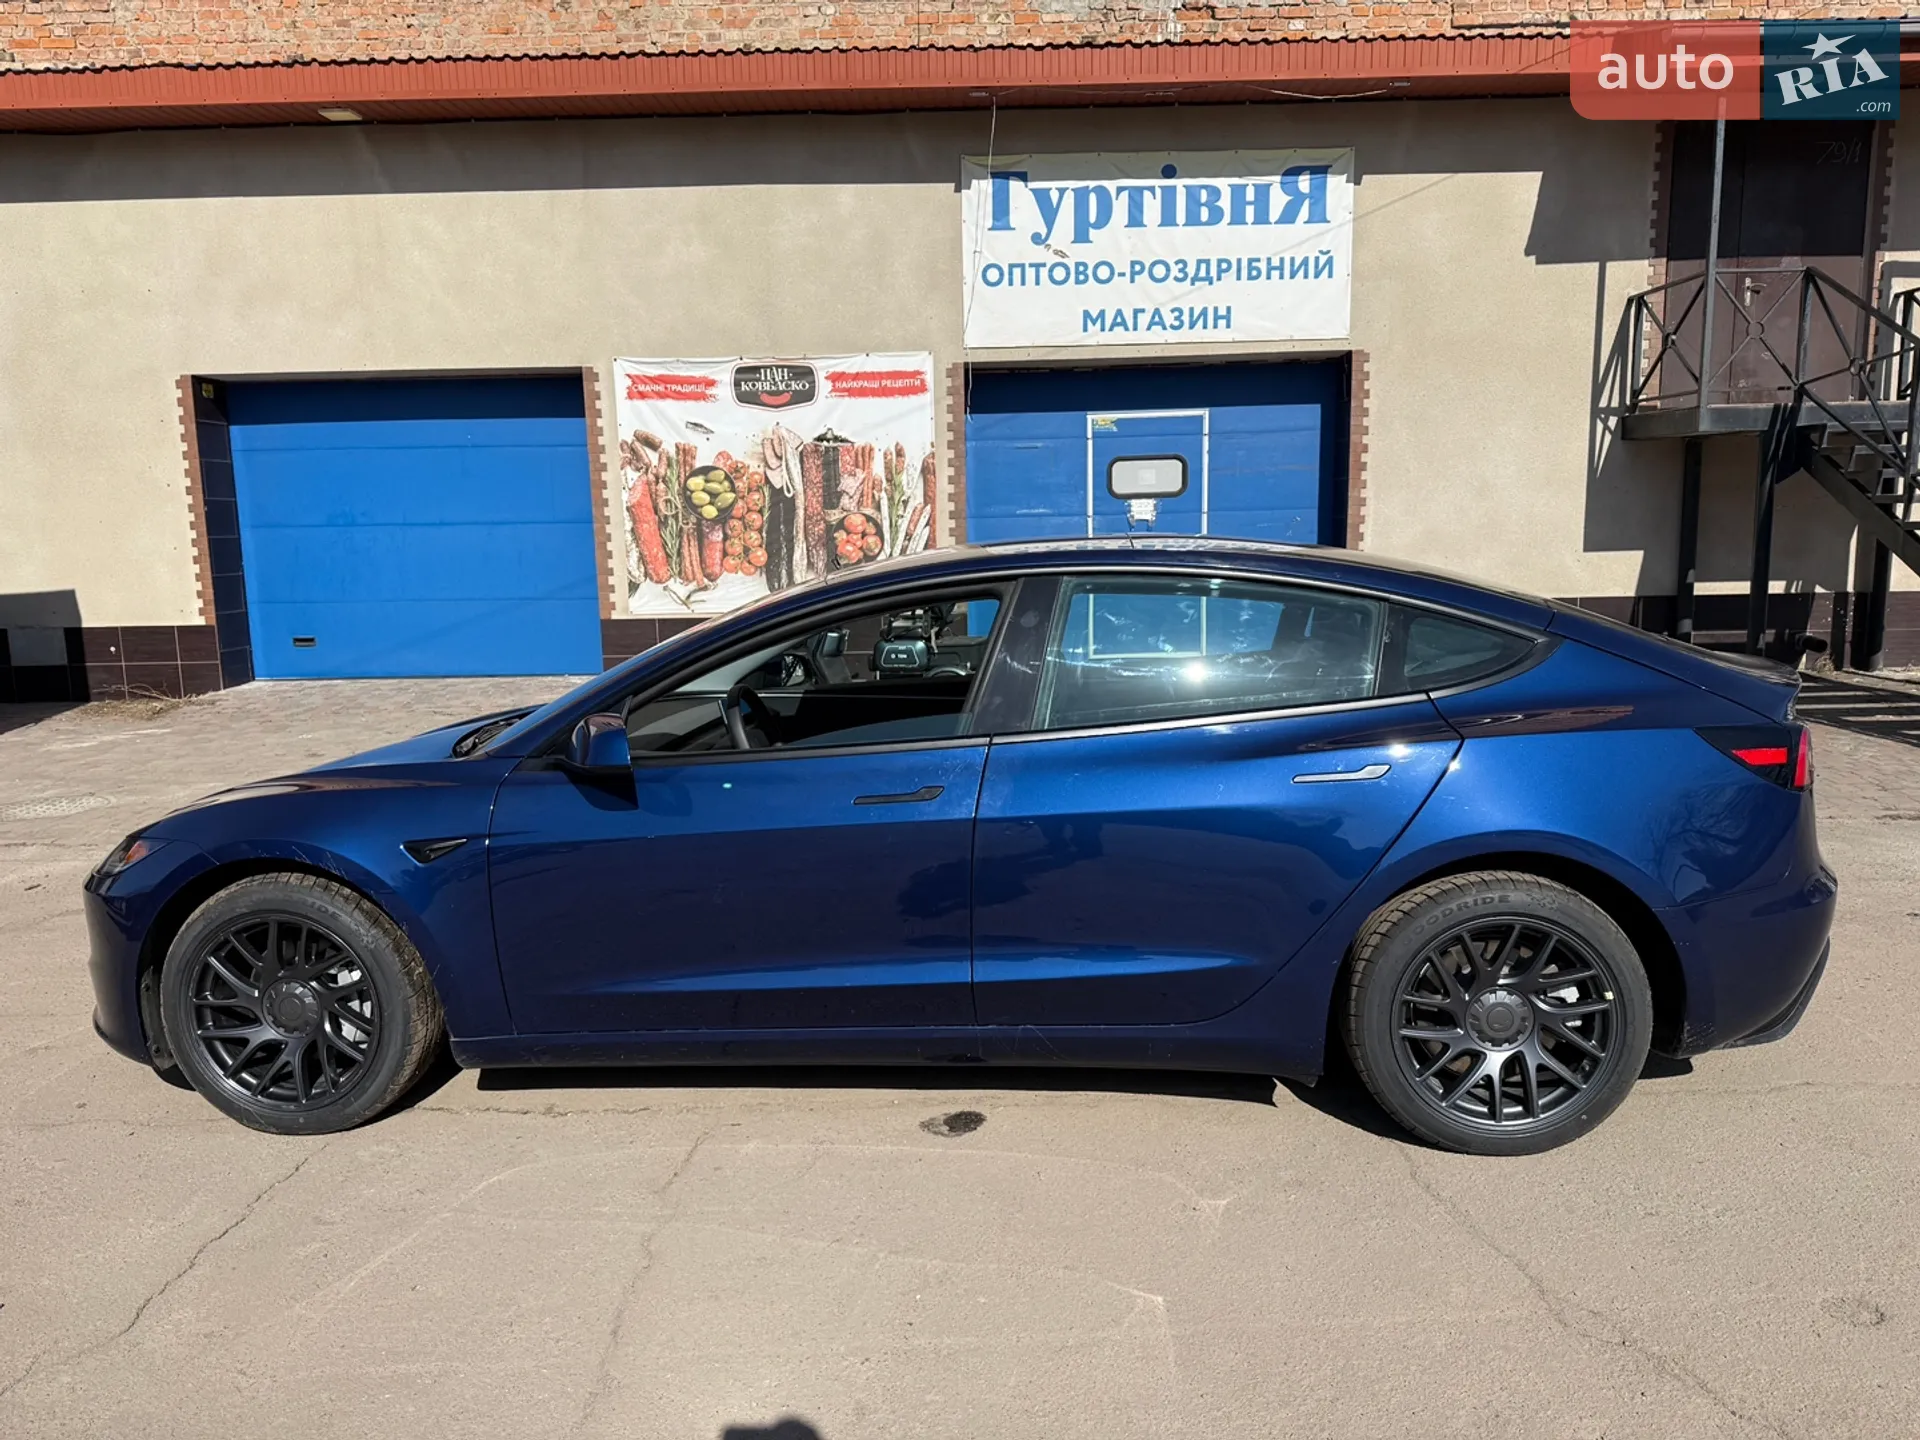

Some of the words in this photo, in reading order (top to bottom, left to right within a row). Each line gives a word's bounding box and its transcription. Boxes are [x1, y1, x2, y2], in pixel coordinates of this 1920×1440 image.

[981, 250, 1334, 288] ОПТОВО-РОЗДРІБНИЙ
[1082, 306, 1232, 333] МАГАЗИН
[760, 366, 788, 383] ПАН
[834, 378, 880, 389] НАЙКРАЩІ
[881, 377, 921, 388] РЕЦЕПТИ
[741, 380, 809, 391] КОВБАСКО
